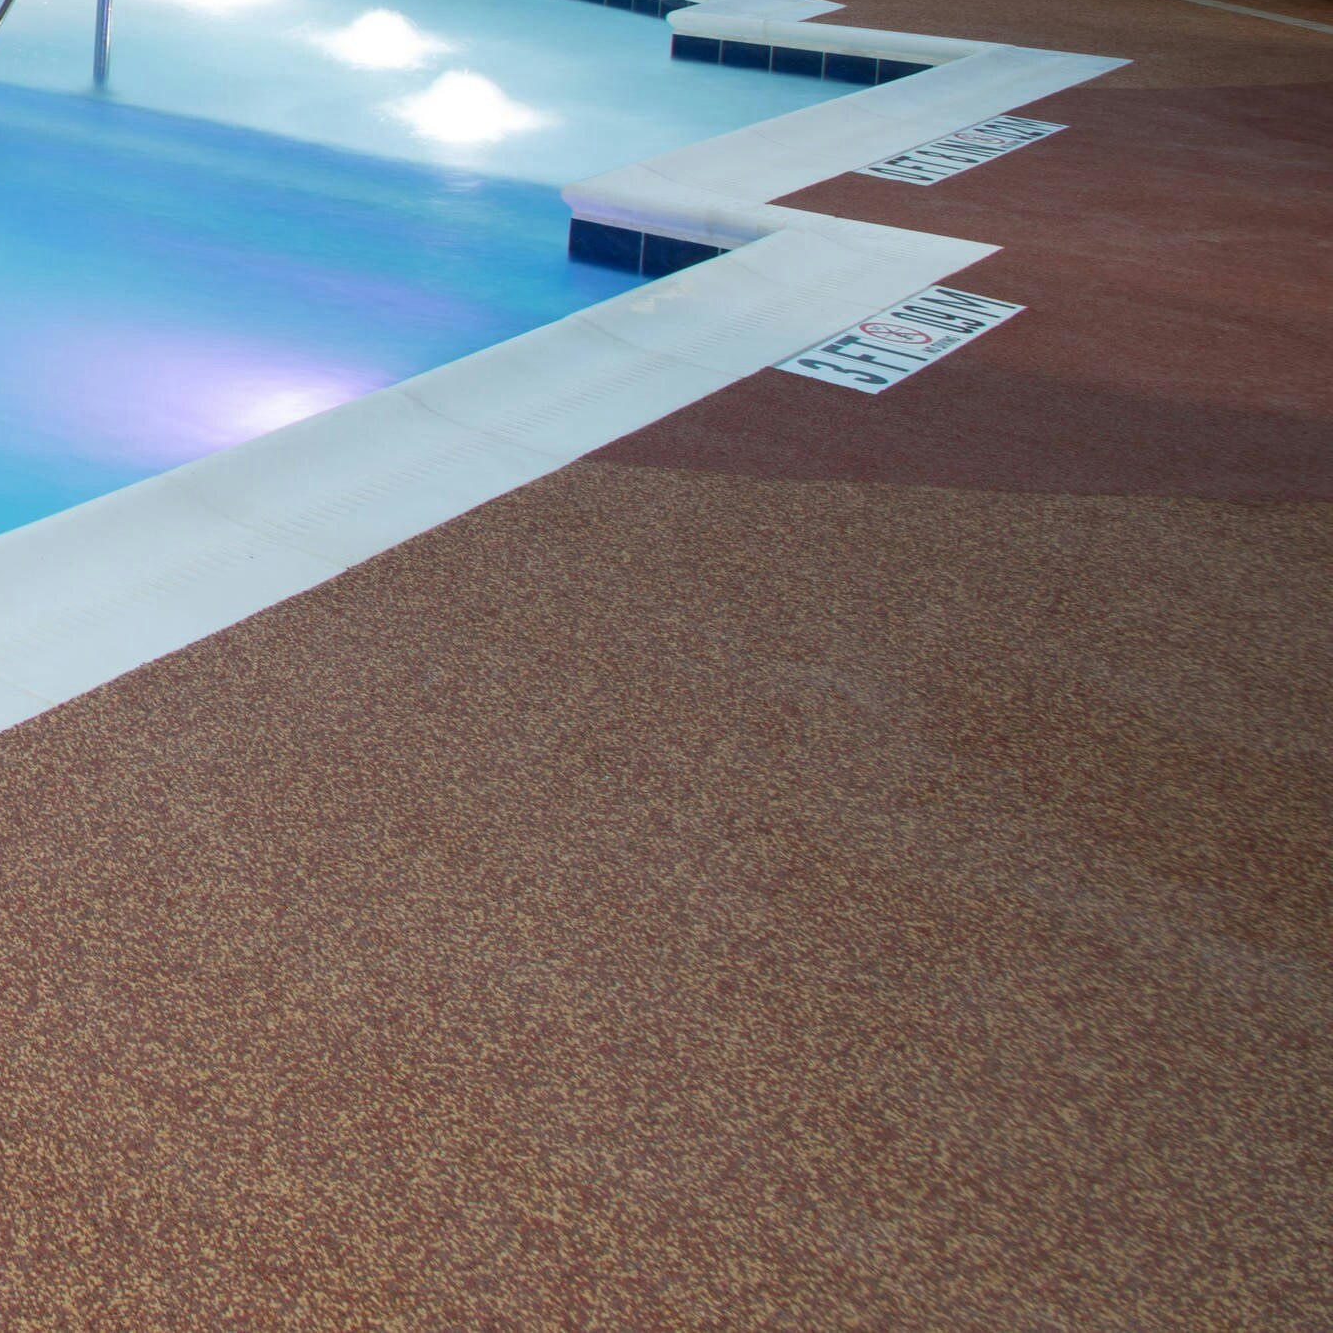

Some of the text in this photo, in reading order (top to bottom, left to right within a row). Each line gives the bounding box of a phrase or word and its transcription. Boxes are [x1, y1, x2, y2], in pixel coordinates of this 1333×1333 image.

[884, 155, 962, 176] FT
[930, 139, 1008, 157] IN
[797, 358, 889, 385] 3
[820, 335, 929, 373] FT
